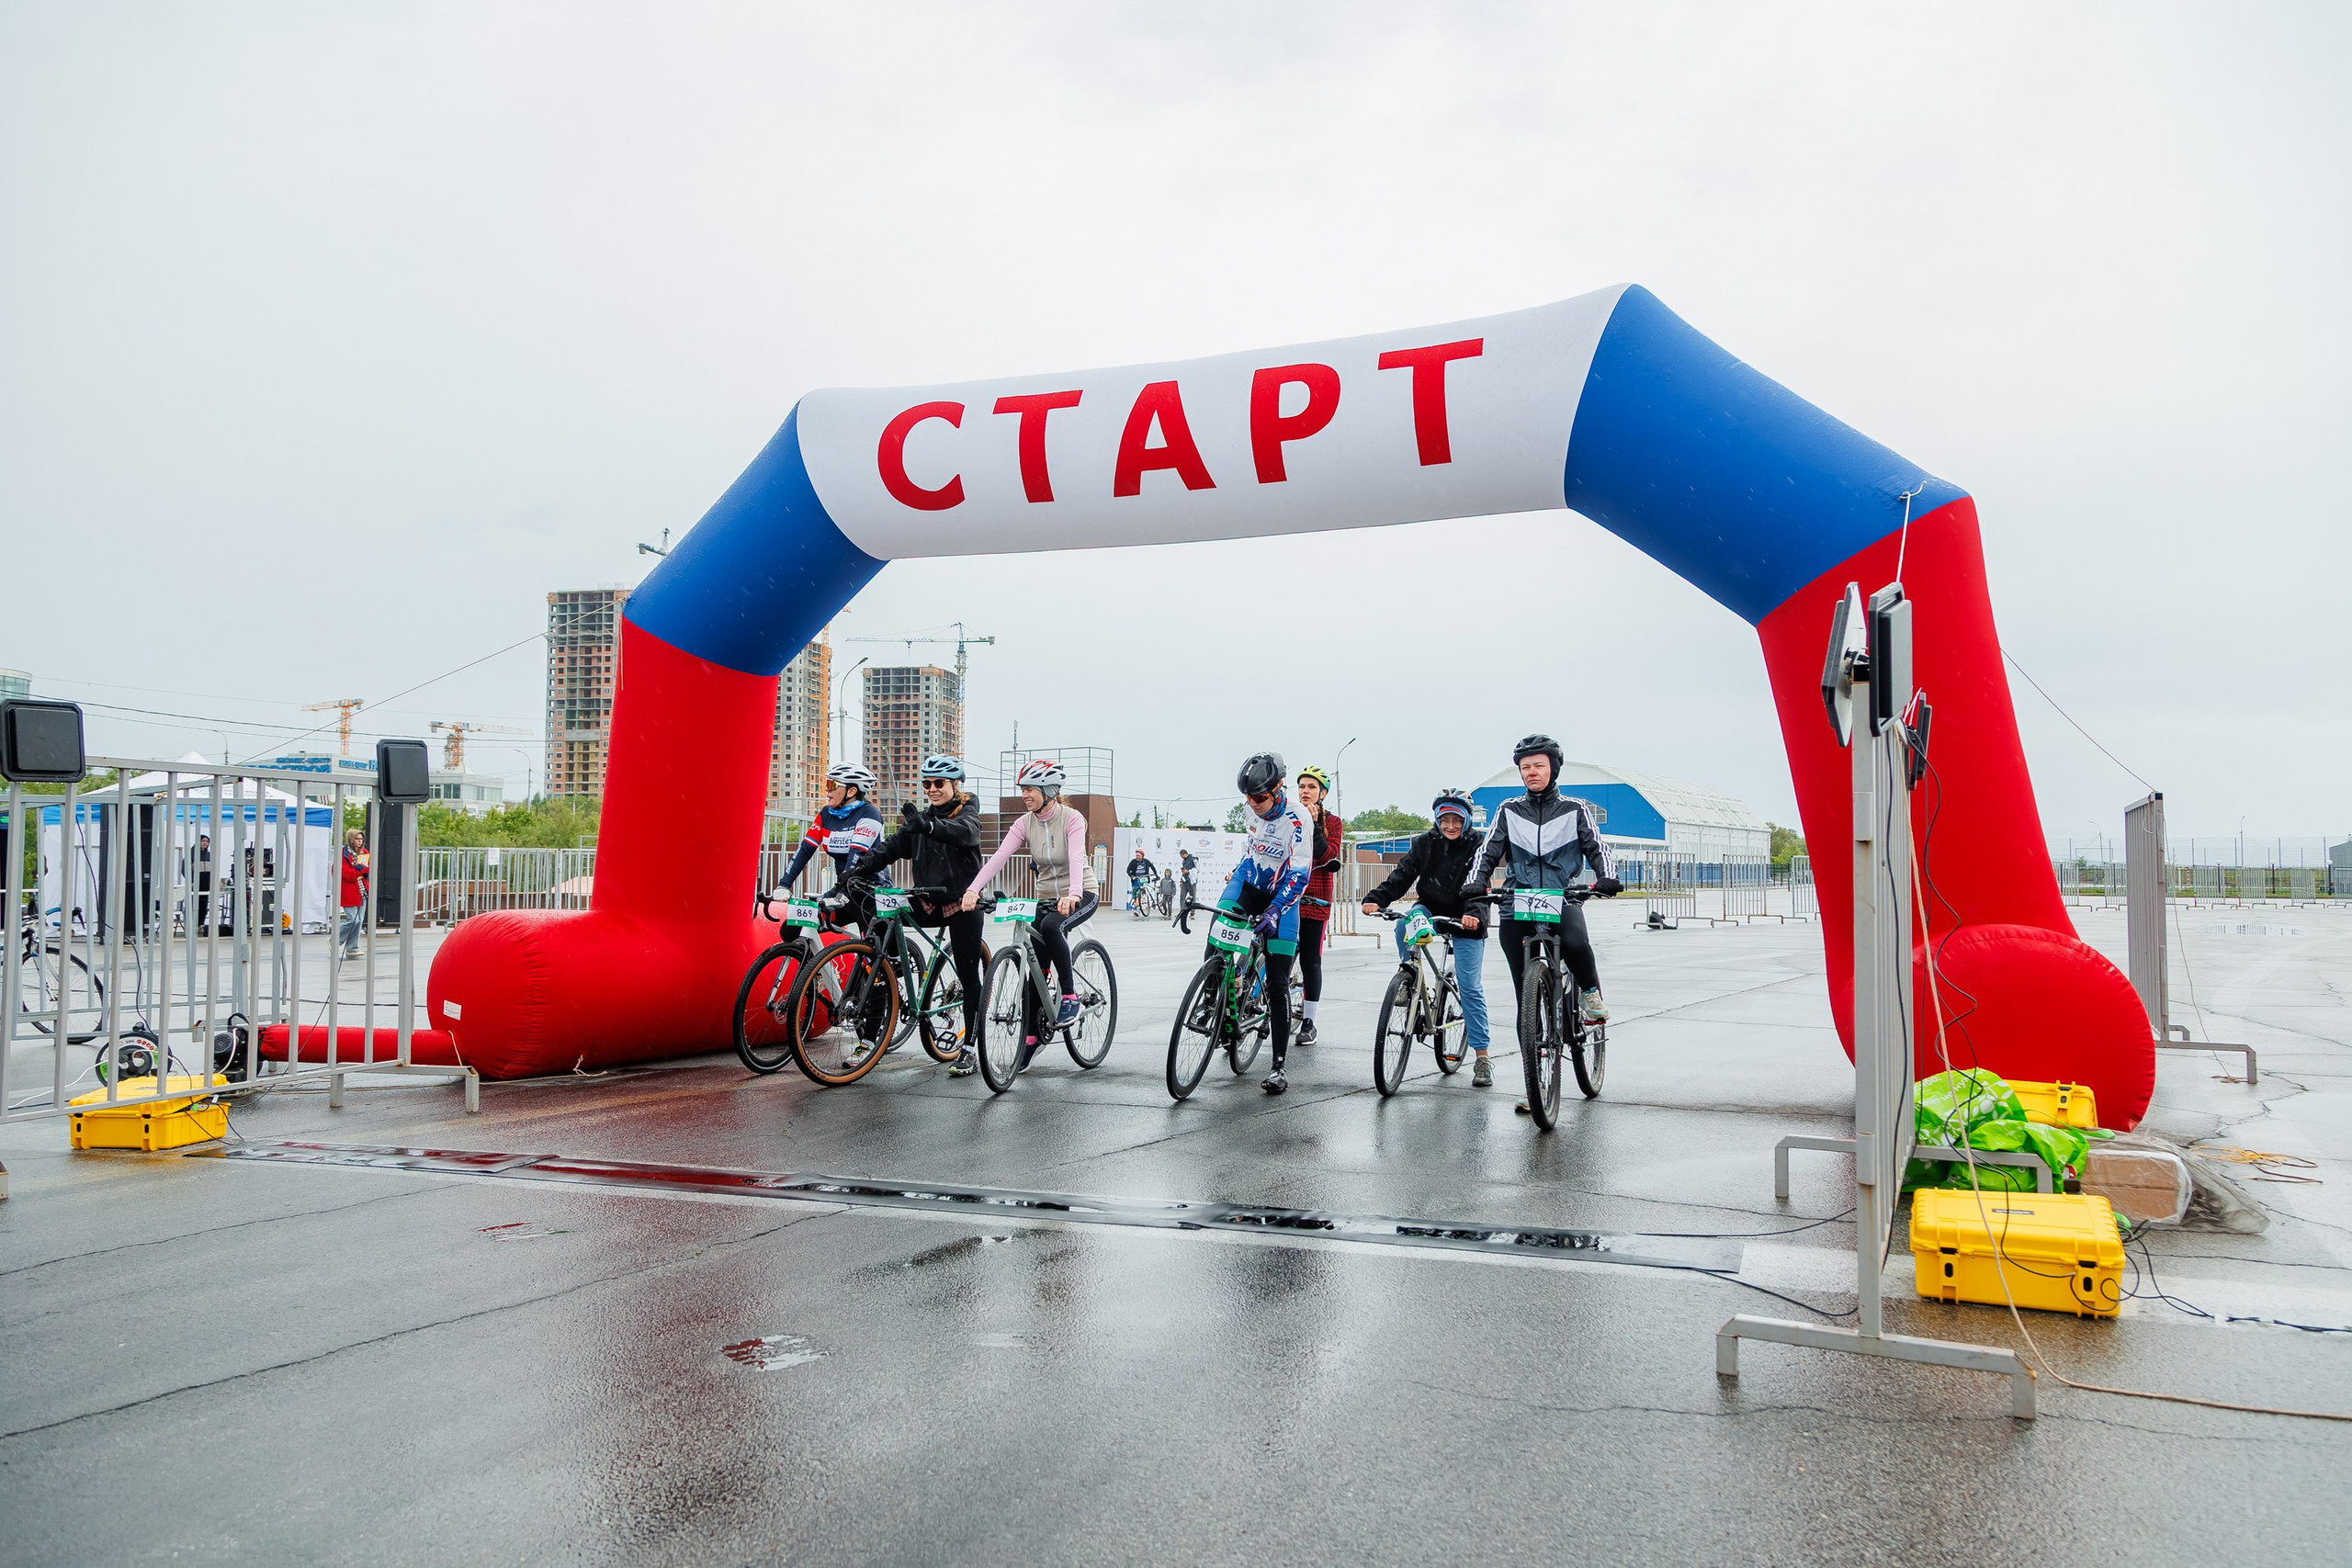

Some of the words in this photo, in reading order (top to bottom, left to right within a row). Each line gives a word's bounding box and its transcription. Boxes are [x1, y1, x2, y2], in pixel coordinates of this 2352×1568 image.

[877, 337, 1485, 512] СТАРТ
[1285, 811, 1303, 843] ITERA
[1007, 903, 1025, 914] 847
[1527, 897, 1548, 909] 924
[796, 908, 813, 918] 869
[1220, 929, 1240, 942] 856
